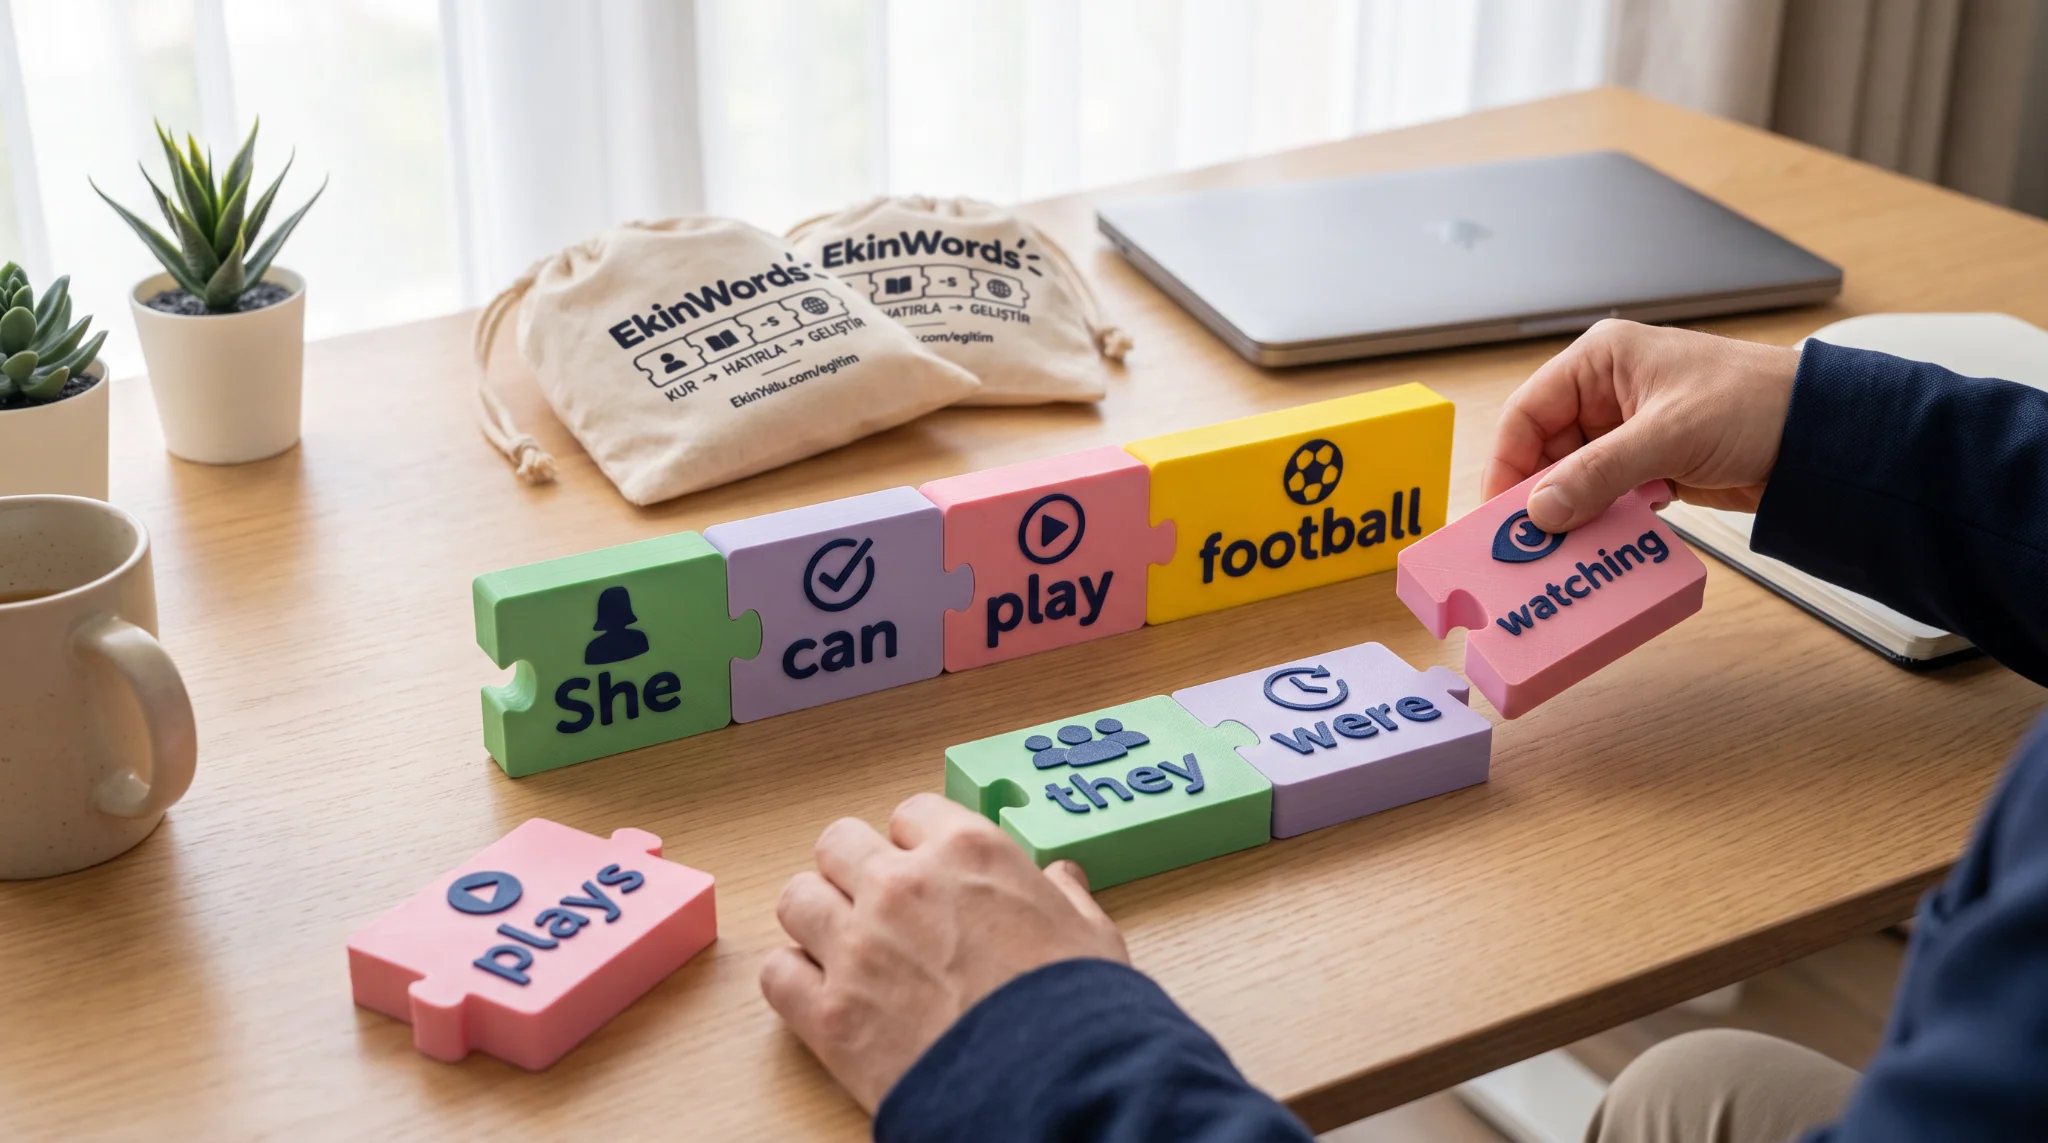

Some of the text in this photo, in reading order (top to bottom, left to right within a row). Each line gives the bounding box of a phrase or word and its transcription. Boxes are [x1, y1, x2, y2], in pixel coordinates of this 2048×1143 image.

[822, 230, 1021, 270] EkinWords
[608, 263, 811, 349] EkinWords
[664, 380, 700, 402] KUR
[721, 344, 788, 376] HATIRLA
[555, 486, 1423, 735] She can play football
[1496, 529, 1670, 636] watching
[1045, 696, 1442, 814] they were
[473, 863, 645, 986] plays
